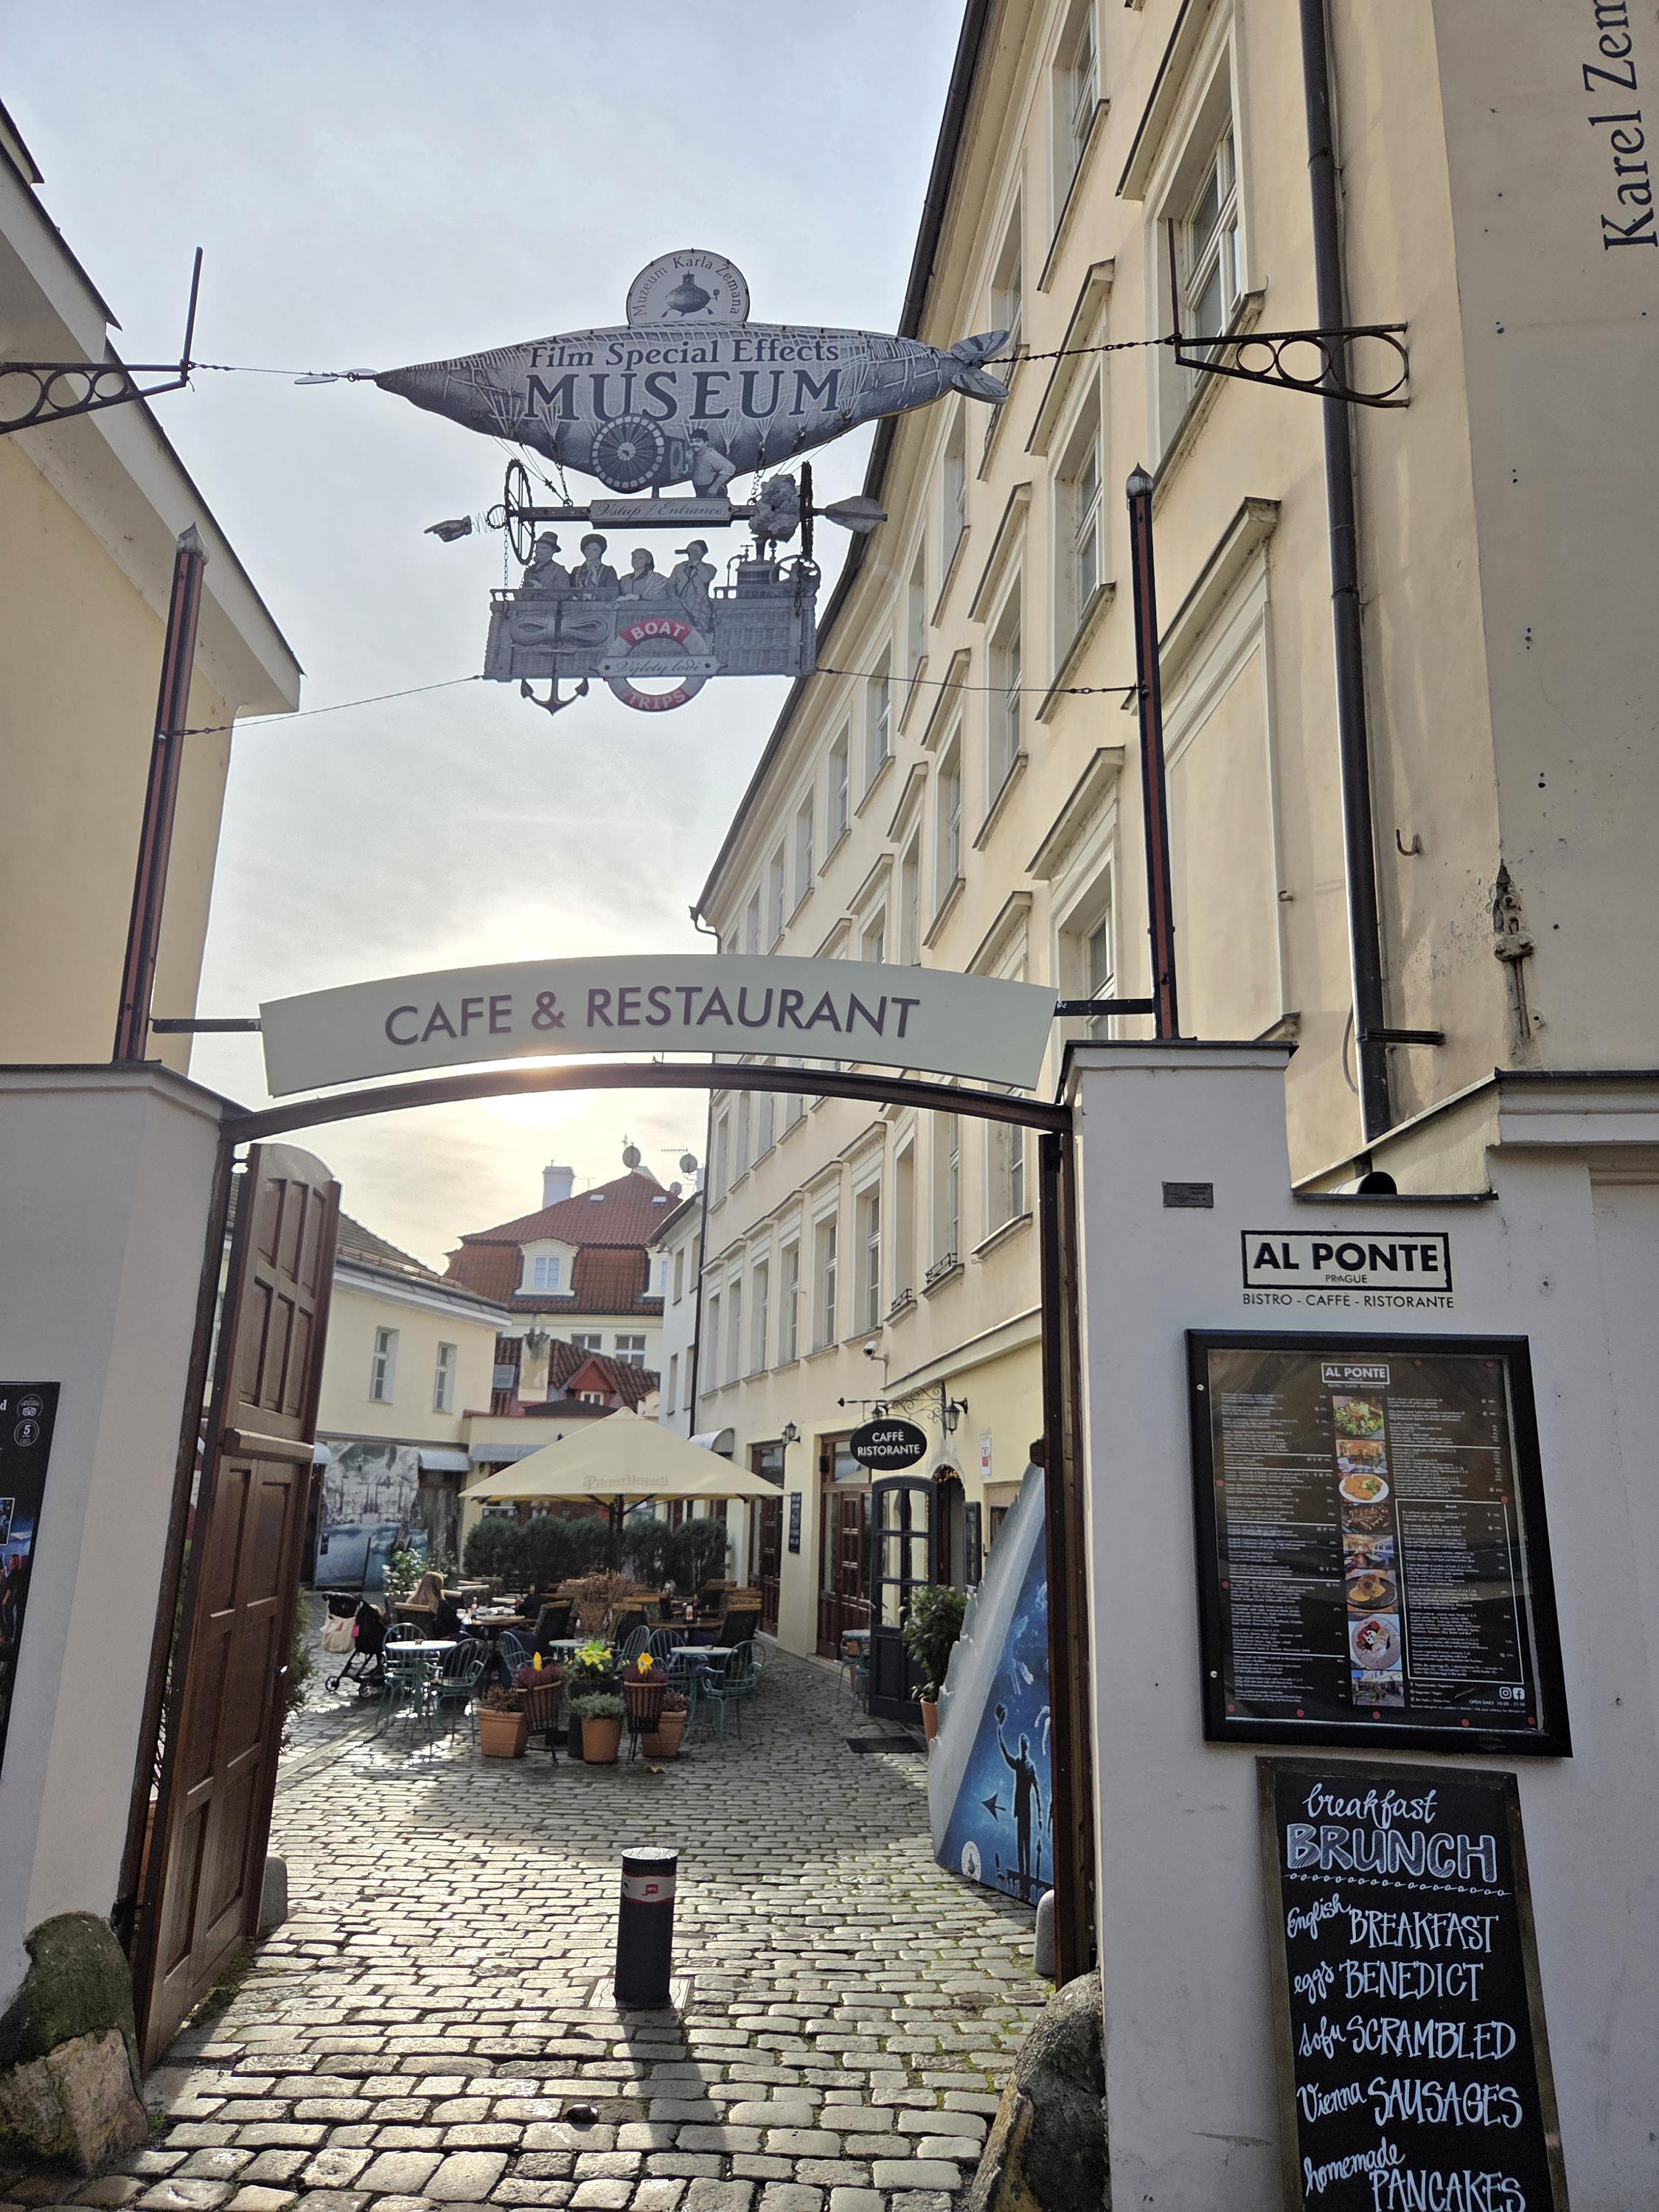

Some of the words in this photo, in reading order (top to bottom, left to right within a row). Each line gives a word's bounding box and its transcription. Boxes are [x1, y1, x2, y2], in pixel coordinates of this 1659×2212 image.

[1587, 110, 1658, 251] Karel
[632, 267, 668, 316] Muzeum
[672, 256, 713, 269] Karla
[715, 263, 741, 314] Zemana
[529, 344, 594, 368] Film
[605, 340, 720, 370] Special
[732, 338, 839, 362] Effects
[524, 369, 842, 421] MUSEUM
[595, 504, 641, 521] Vstup
[658, 501, 723, 515] Entrance
[630, 622, 685, 641] BOAT
[628, 689, 686, 709] TRIPS
[385, 994, 512, 1046] CAFE
[531, 990, 566, 1029] &
[587, 986, 920, 1038] RESTAURANT
[1253, 1242, 1299, 1269] AL
[1312, 1242, 1439, 1272] PONTE
[1325, 1273, 1368, 1284] PRAGUE
[1242, 1293, 1293, 1305] BISTRO
[1305, 1292, 1351, 1307] CAFFÈ
[1363, 1295, 1454, 1308] RISTORANTE
[1325, 1367, 1341, 1377] AL
[1344, 1367, 1386, 1378] PONTE
[23, 1425, 31, 1435] 5
[872, 1430, 905, 1442] CAFFÈ
[857, 1444, 920, 1456] RISTORANTE
[1302, 1782, 1437, 1829] breakfast
[1287, 1823, 1498, 1882] BRUNCH
[1287, 1893, 1350, 1940] English
[1349, 1908, 1499, 1952] BREAKFAST
[1293, 1961, 1334, 2004] eggs
[1338, 1959, 1484, 2002] BENEDICT
[1346, 2015, 1516, 2059] SCRAMBLED
[1296, 2082, 1367, 2123] Vienna
[1368, 2076, 1523, 2129] SAUSAGES
[1303, 2136, 1405, 2197] homemade
[1369, 2168, 1526, 2212] PANCAKES
